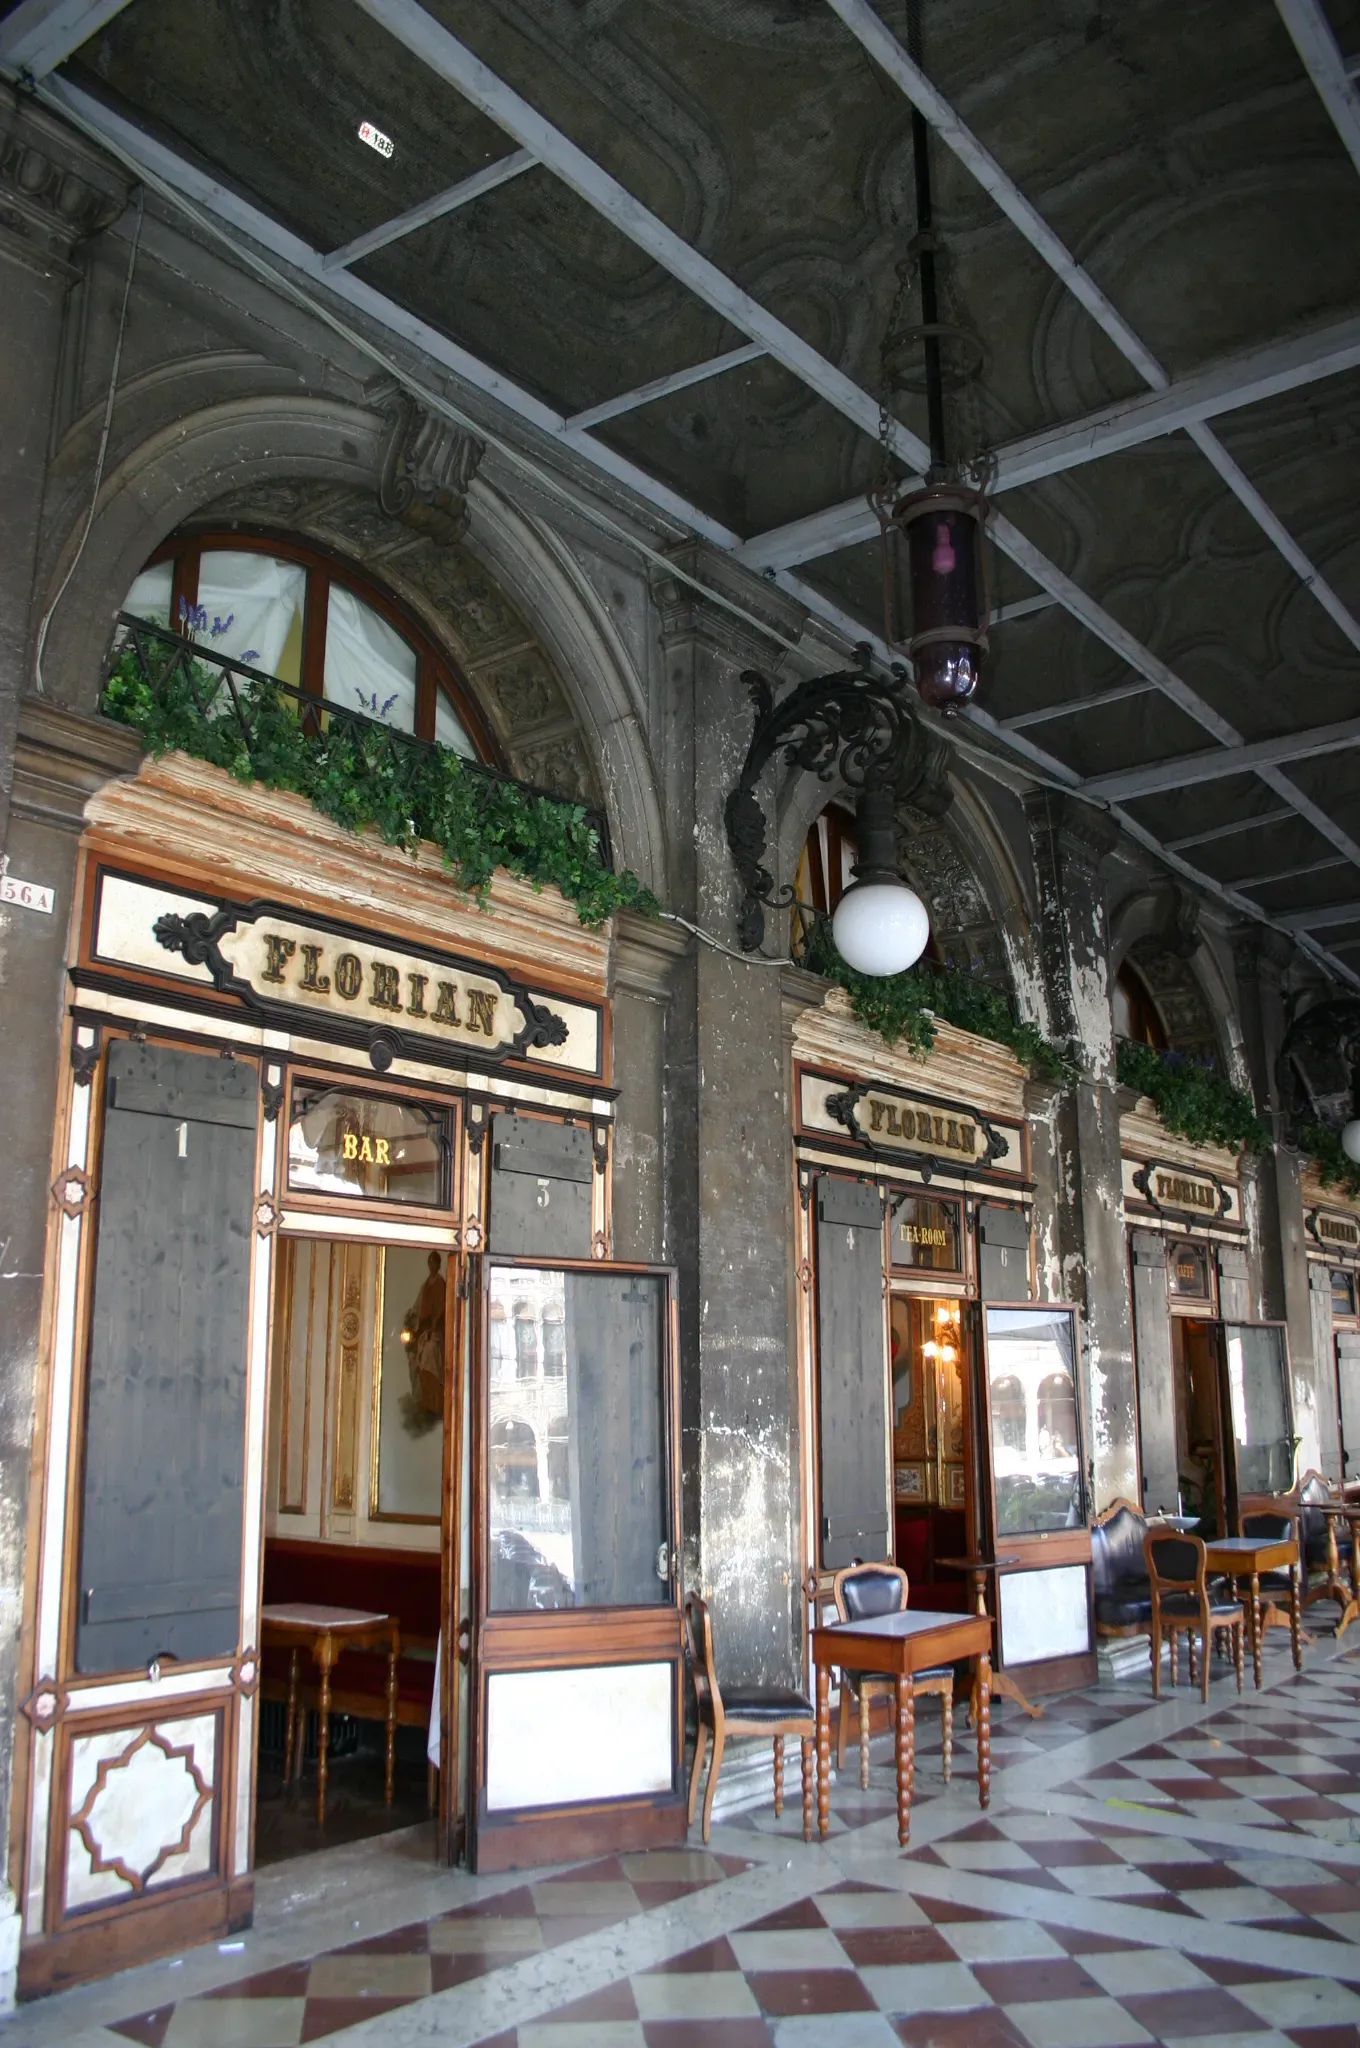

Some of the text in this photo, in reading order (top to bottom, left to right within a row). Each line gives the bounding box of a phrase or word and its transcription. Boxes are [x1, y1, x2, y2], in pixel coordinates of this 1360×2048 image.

[261, 933, 499, 1037] FLORIAN
[175, 1122, 188, 1158] 1
[869, 1099, 976, 1155] FLORIAN
[342, 1133, 391, 1165] BAR
[1156, 1173, 1215, 1209] FLORIAN
[846, 1228, 855, 1250] 4
[899, 1224, 947, 1247] TEA-ROOM
